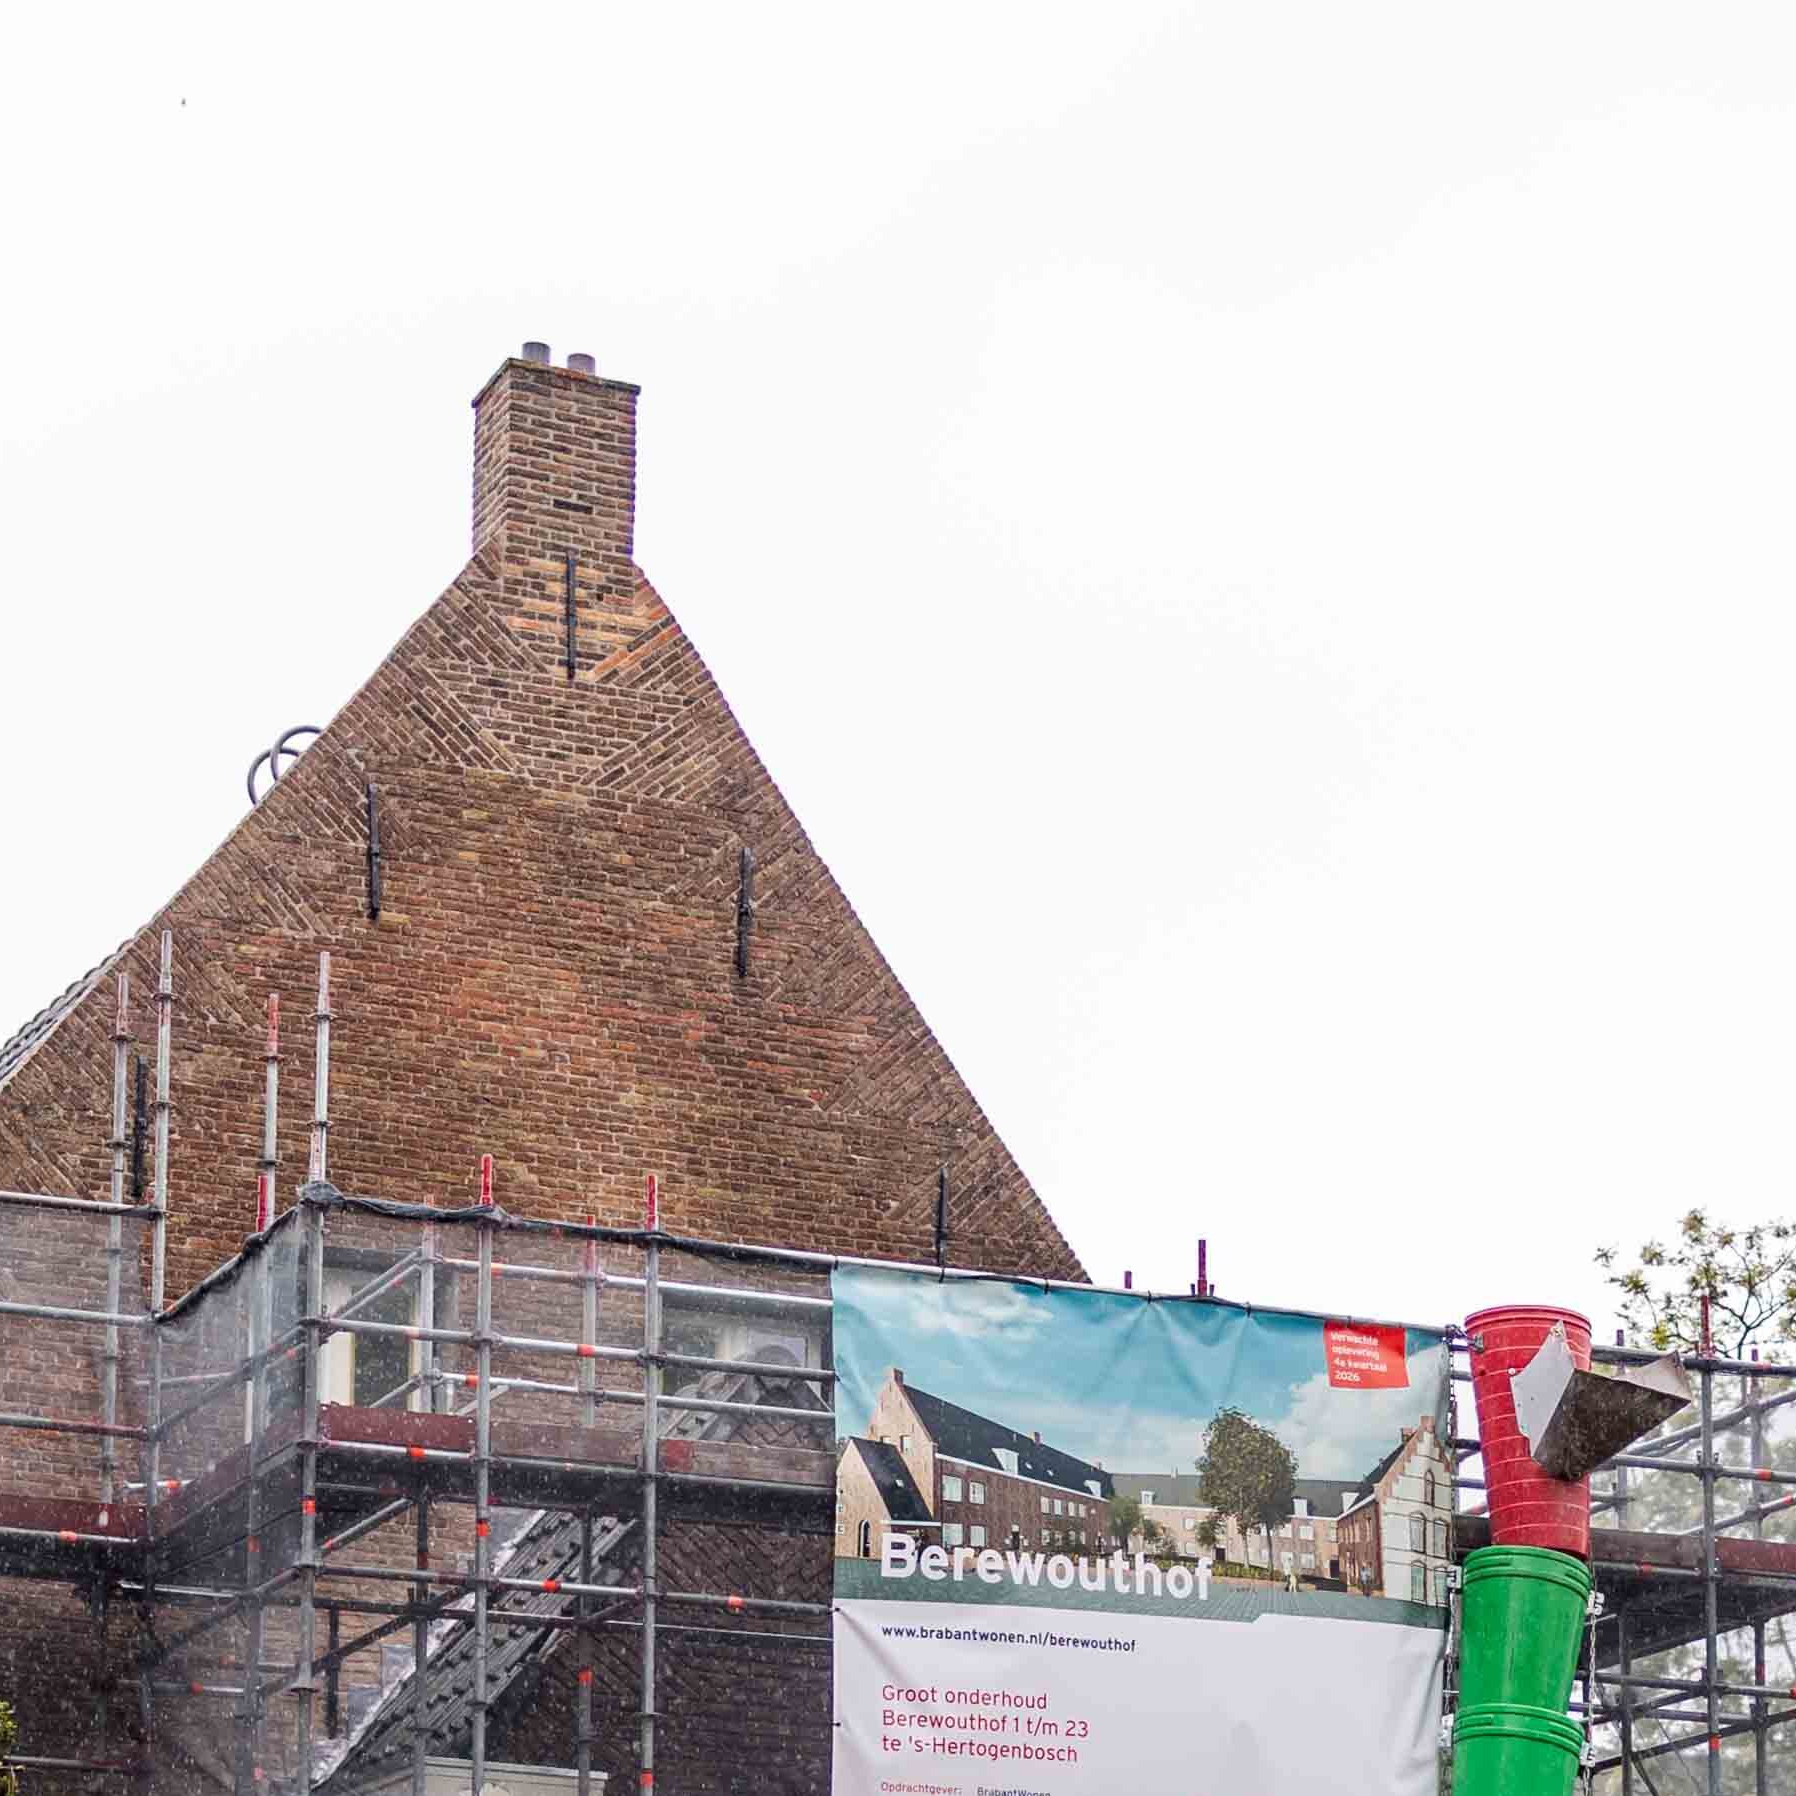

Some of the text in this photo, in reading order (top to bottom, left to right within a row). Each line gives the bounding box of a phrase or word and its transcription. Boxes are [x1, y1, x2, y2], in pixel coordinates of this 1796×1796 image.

[880, 1532, 1212, 1600] Berewouthof
[882, 1623, 1136, 1652] www.brabantwonen.nl/berewouthof
[882, 1685, 1048, 1710] Groot onderhoud
[883, 1709, 1089, 1738] Berewouthof 1 t/m 23
[883, 1735, 1078, 1762] te 's-Hertogenbosch
[881, 1782, 963, 1796] Opdrachtgever:
